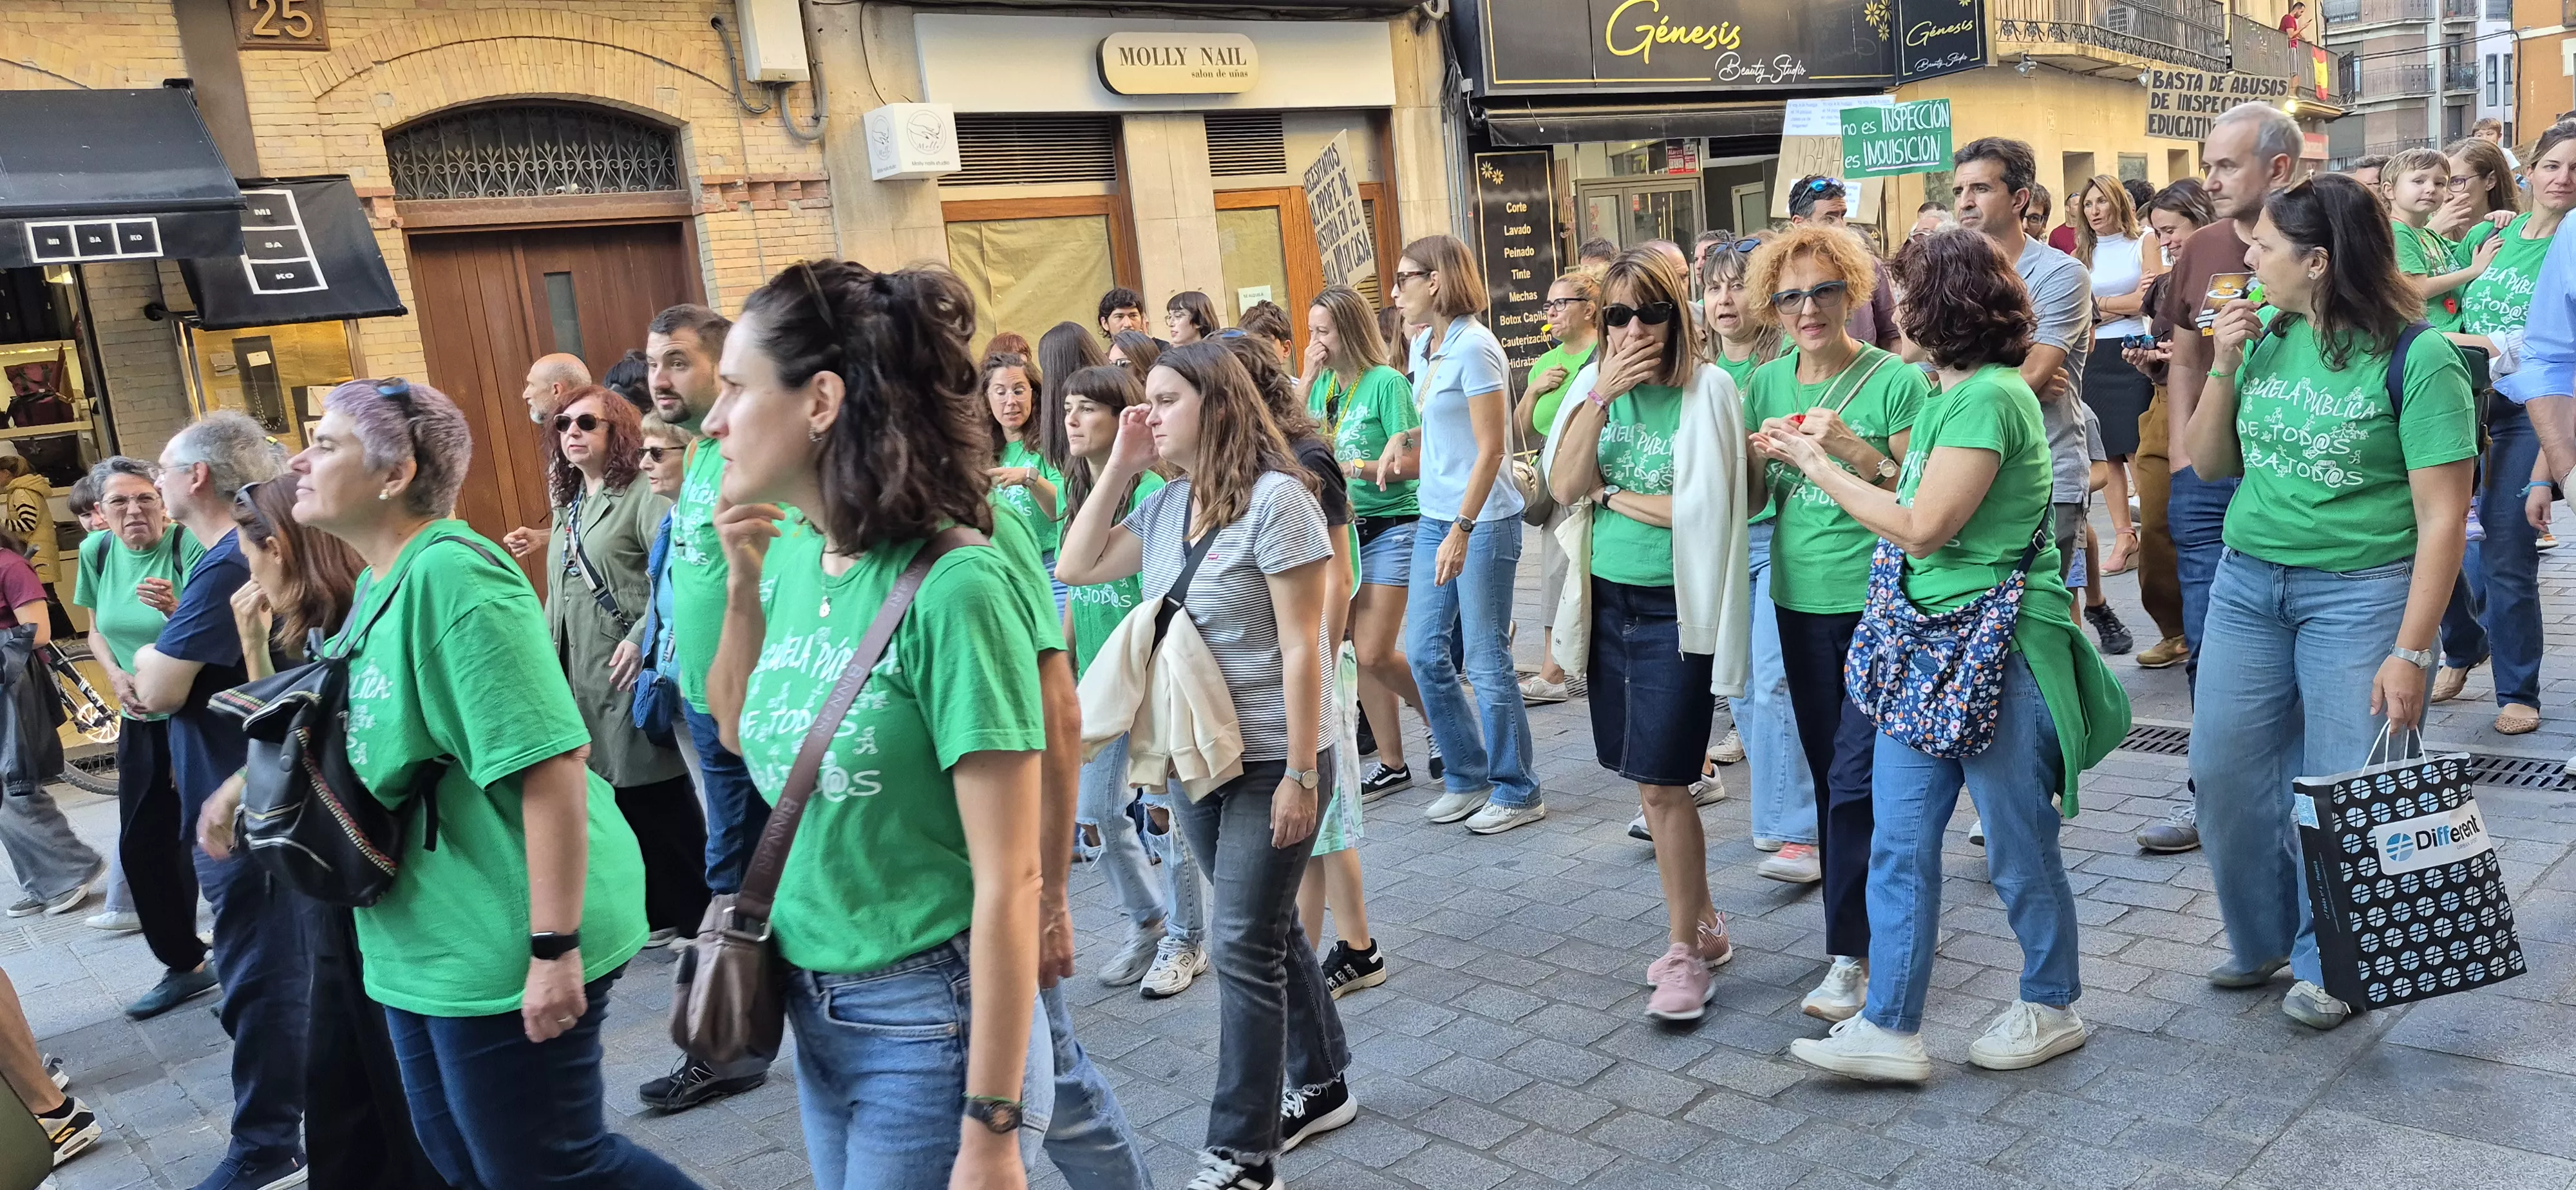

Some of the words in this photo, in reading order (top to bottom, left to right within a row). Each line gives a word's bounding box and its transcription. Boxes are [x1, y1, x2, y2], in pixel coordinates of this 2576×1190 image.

[249, 0, 314, 38] 25
[1605, 0, 1741, 64] Génesis
[1906, 19, 1973, 46] Génesis
[1118, 46, 1188, 66] MOLLY
[1200, 47, 1247, 66] NAIL
[1915, 58, 1946, 72] Beauty
[1946, 52, 1968, 67] Studio
[1191, 68, 1214, 78] salon
[1216, 68, 1226, 78] de
[1229, 68, 1248, 78] uñas
[1714, 51, 1770, 83] Beauty
[1770, 54, 1806, 83] Studio
[2152, 70, 2203, 92] BASTA
[2209, 75, 2224, 92] DE
[2230, 77, 2287, 97] ABUSOS
[2150, 92, 2170, 110] DE
[1842, 124, 1857, 136] no
[1861, 120, 1877, 135] es
[1881, 101, 1950, 133] INSPECCIÓN
[1844, 155, 1861, 169] es
[1316, 176, 1341, 222] PROFE
[1339, 167, 1353, 201] DE
[1338, 207, 1350, 236] EN
[1348, 200, 1361, 227] EL
[1506, 202, 1528, 214] Corte
[47, 237, 61, 246] MI
[89, 235, 102, 243] SA
[129, 233, 143, 242] KO
[1504, 223, 1531, 236] Lavado
[265, 241, 283, 249] SA
[1351, 229, 1372, 268] CASA
[1504, 245, 1535, 258] Peinado
[276, 272, 295, 280] KO
[1511, 269, 1531, 280] Tinte
[1509, 290, 1538, 303] Mechas
[1499, 314, 1522, 326] Botox
[1501, 331, 1552, 348] Cauterización
[2239, 419, 2259, 438] DE
[2269, 423, 2351, 455] TOD@S
[2284, 456, 2364, 489] TOD@S
[2416, 814, 2481, 851] Different
